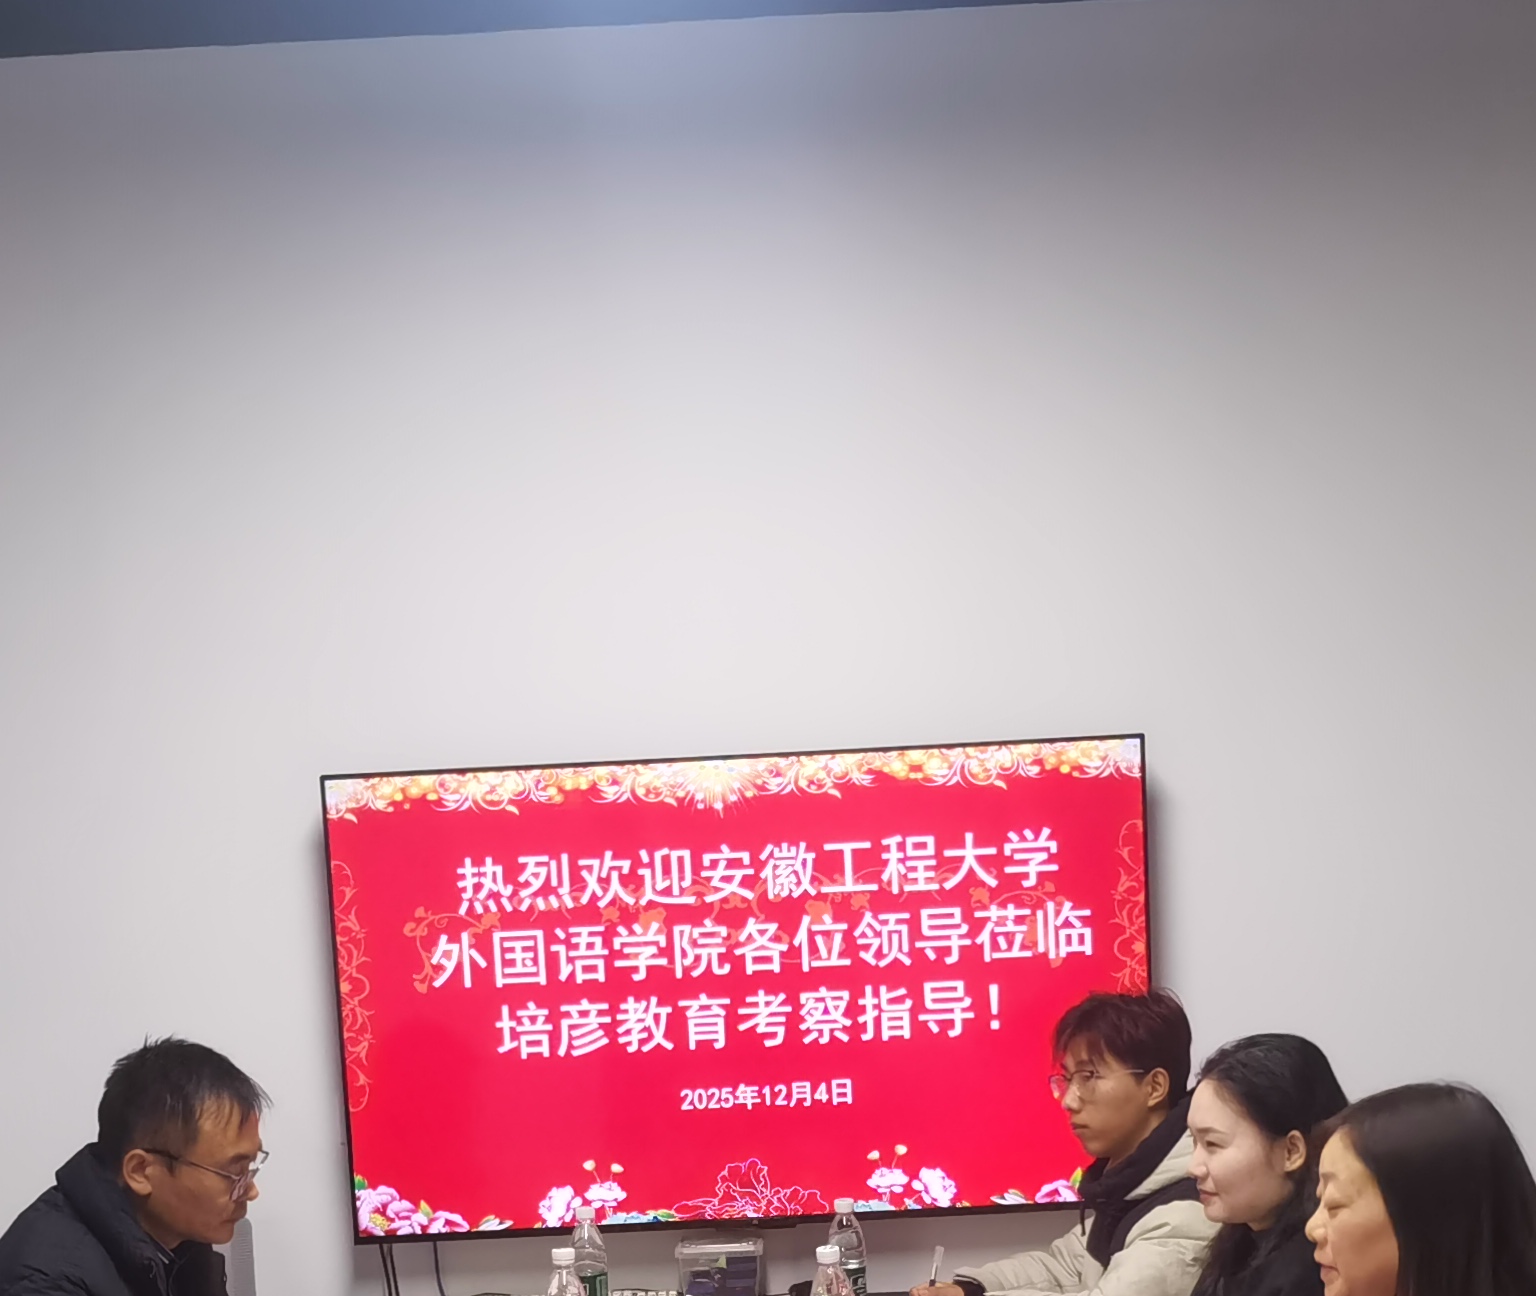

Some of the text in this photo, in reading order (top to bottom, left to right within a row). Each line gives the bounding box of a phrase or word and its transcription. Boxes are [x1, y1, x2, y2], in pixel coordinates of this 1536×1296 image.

[455, 826, 1060, 916] 热烈欢迎安徽工程大学
[429, 899, 1094, 990] 外国语学院各位领导莅临
[495, 980, 1003, 1061] 培彦教育考察指导！
[680, 1077, 855, 1112] 2025年12月4日
